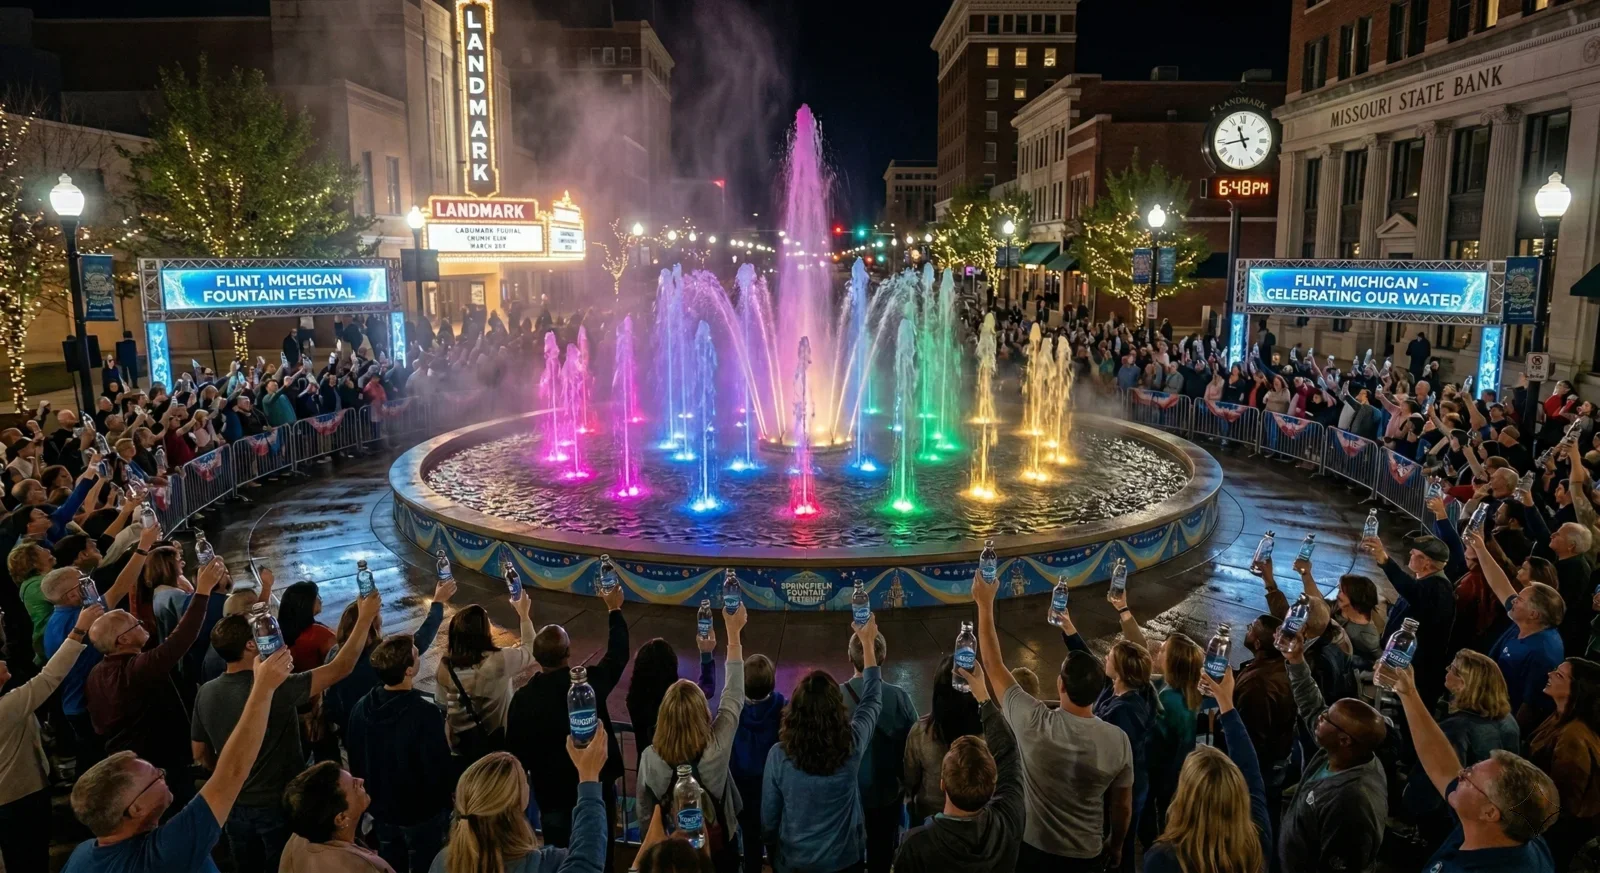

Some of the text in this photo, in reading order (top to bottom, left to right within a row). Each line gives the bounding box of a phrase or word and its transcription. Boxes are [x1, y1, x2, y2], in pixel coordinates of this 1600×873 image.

[466, 11, 489, 181] LANDMARK
[1218, 97, 1268, 110] LANDMARK
[1330, 65, 1503, 128] MISSOURI STATE BANK
[436, 202, 525, 219] LANDMARK
[216, 274, 343, 288] FLINT, MICHIGAN
[1295, 275, 1337, 288] FLINT,
[1341, 275, 1418, 289] MICHIGAN
[203, 288, 355, 302] FOUNTAIN FESTIVAL
[1266, 288, 1461, 307] CELEBRATING OUR WATER
